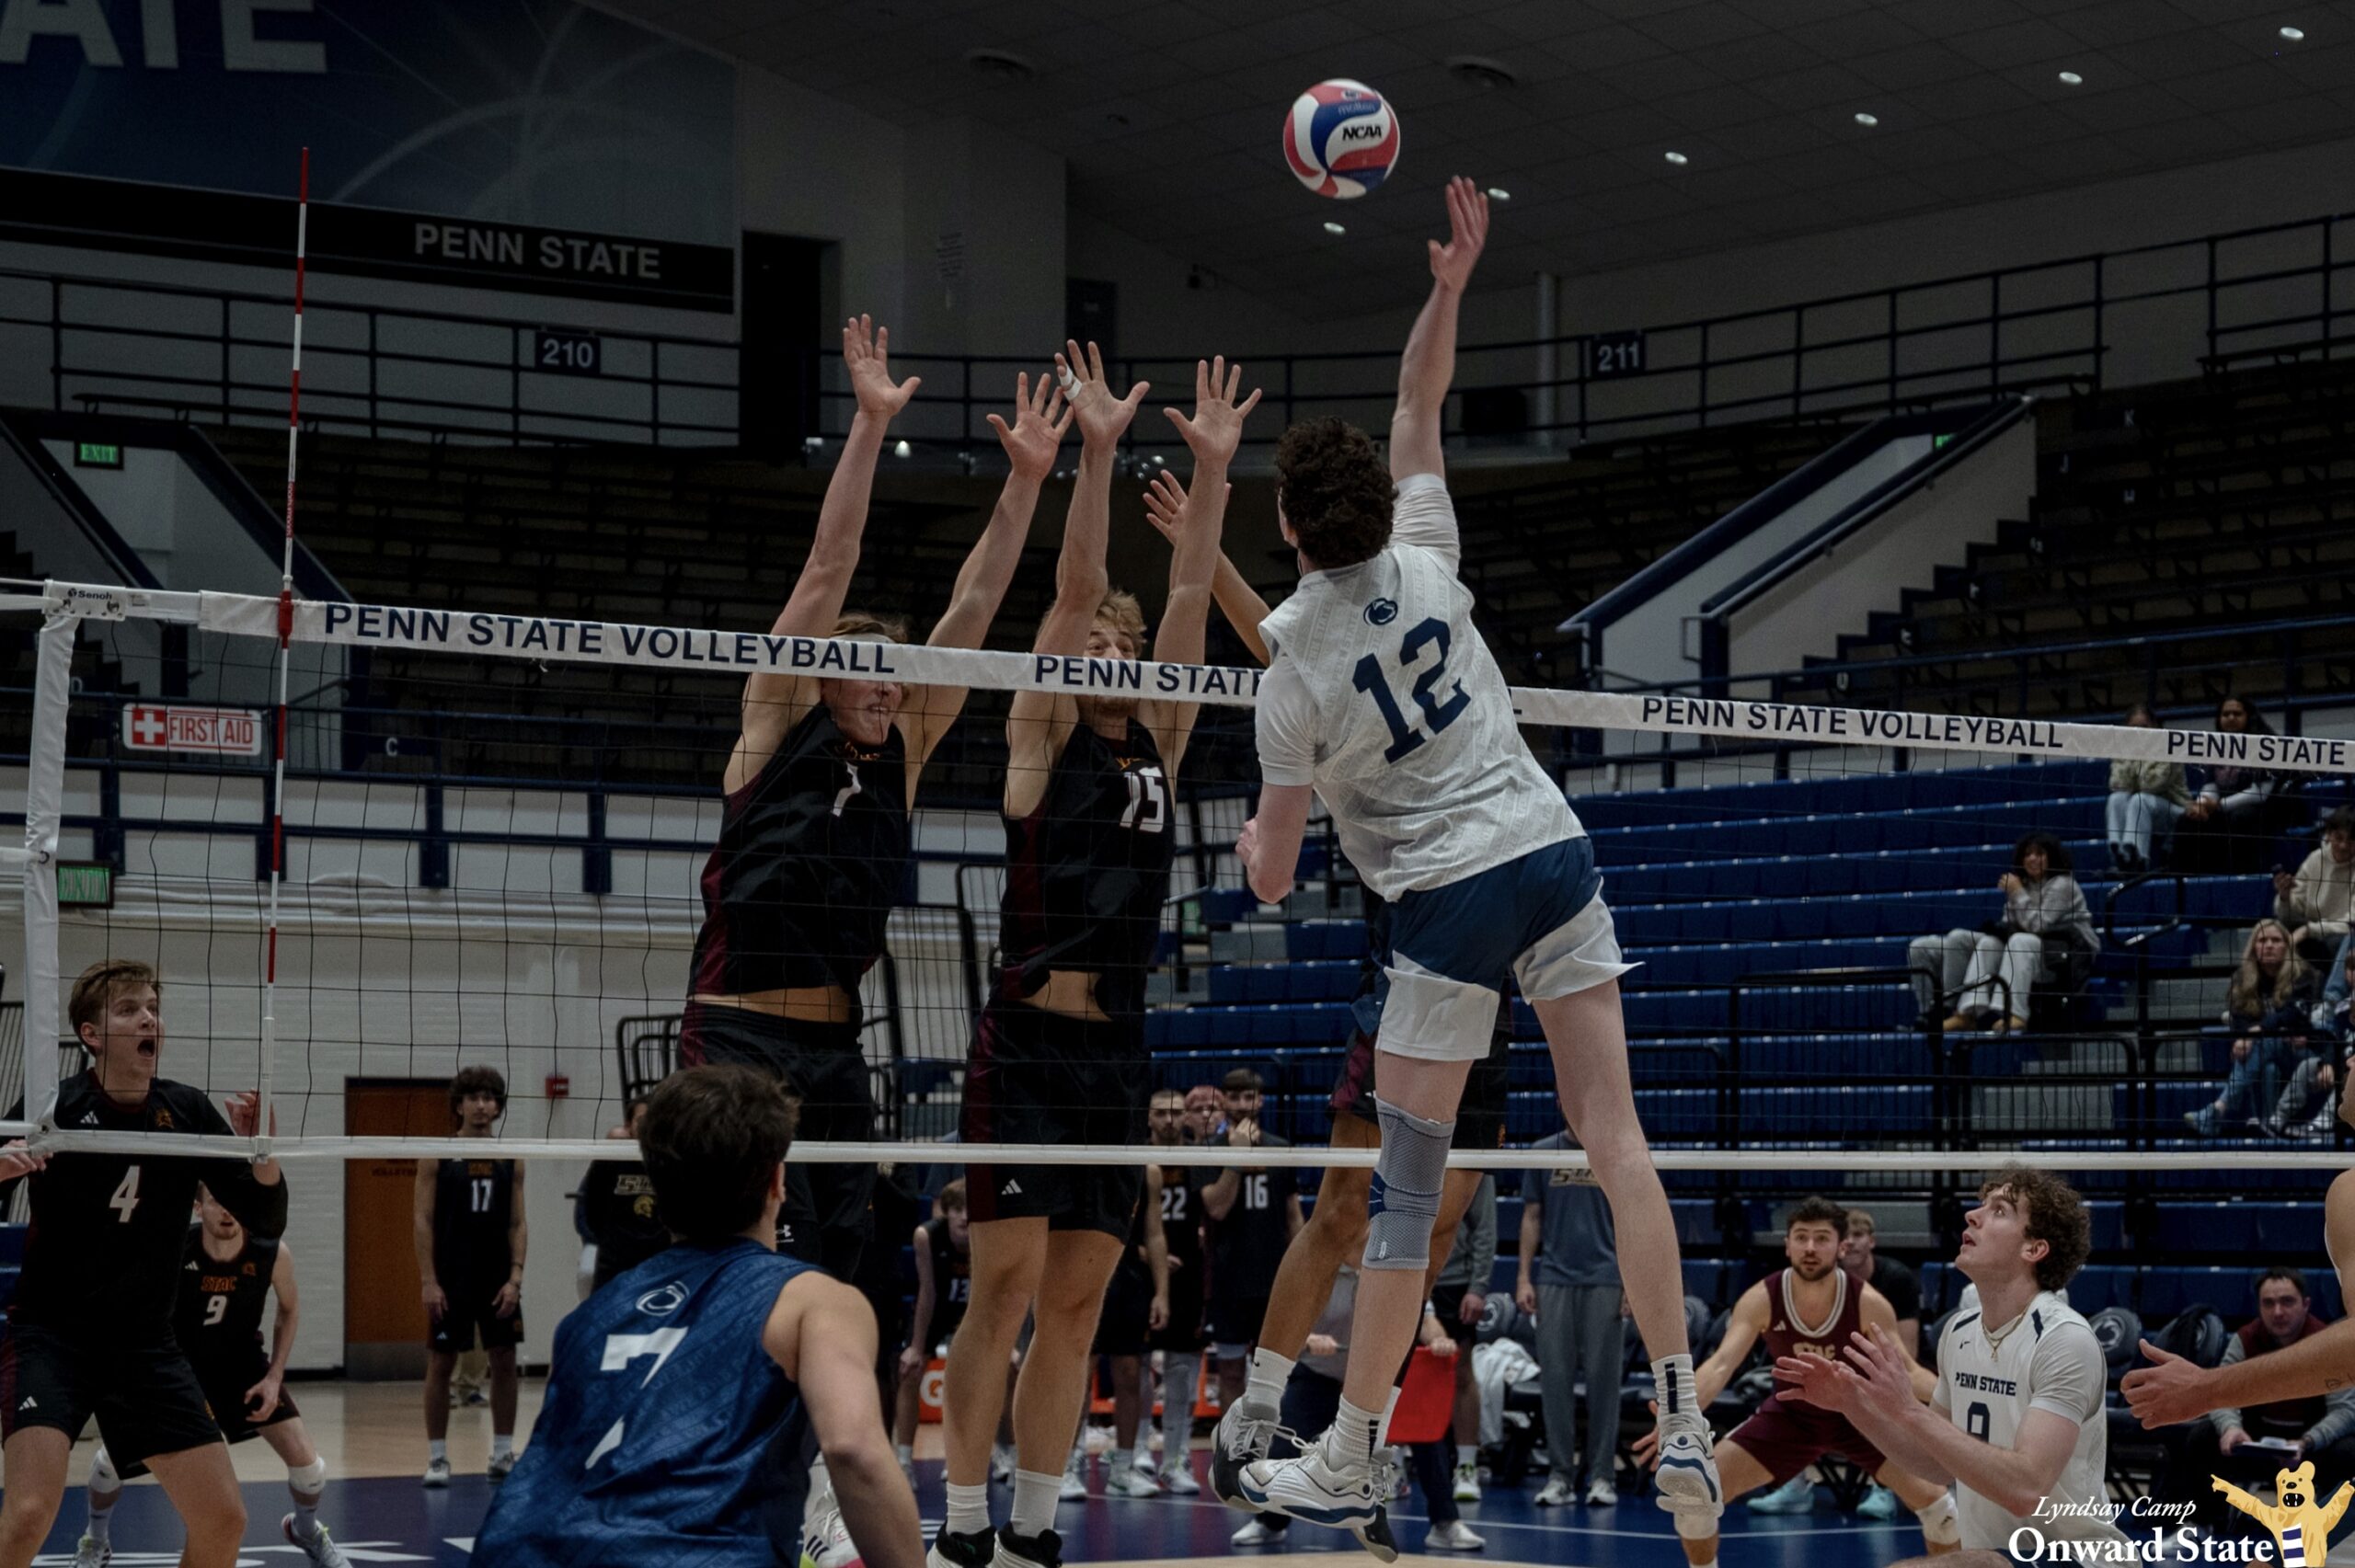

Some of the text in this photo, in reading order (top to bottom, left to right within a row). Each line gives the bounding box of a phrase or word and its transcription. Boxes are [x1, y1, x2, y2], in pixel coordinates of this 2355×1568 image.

[1342, 126, 1382, 141] NCAA
[414, 222, 661, 280] PENN STATE
[541, 338, 594, 368] 210
[1597, 340, 1639, 372] 211
[78, 590, 112, 600] Senoh
[326, 604, 895, 673] PENN STATE VOLLEYBALL
[1035, 656, 1142, 689] PENN
[1352, 617, 1471, 764] 12
[169, 717, 253, 744] FIRST AID
[1643, 697, 2062, 748] PENN STATE VOLLEYBALL
[386, 738, 398, 756] C
[2168, 731, 2345, 765] PENN STATE
[1120, 766, 1165, 833] 15
[109, 1164, 141, 1224] 4
[471, 1179, 493, 1212] 17
[1161, 1185, 1187, 1221] 22
[1245, 1174, 1269, 1210] 16
[201, 1275, 238, 1293] STAC
[203, 1294, 228, 1326] 9
[584, 1326, 688, 1471] 7
[1980, 1376, 2016, 1397] STATE
